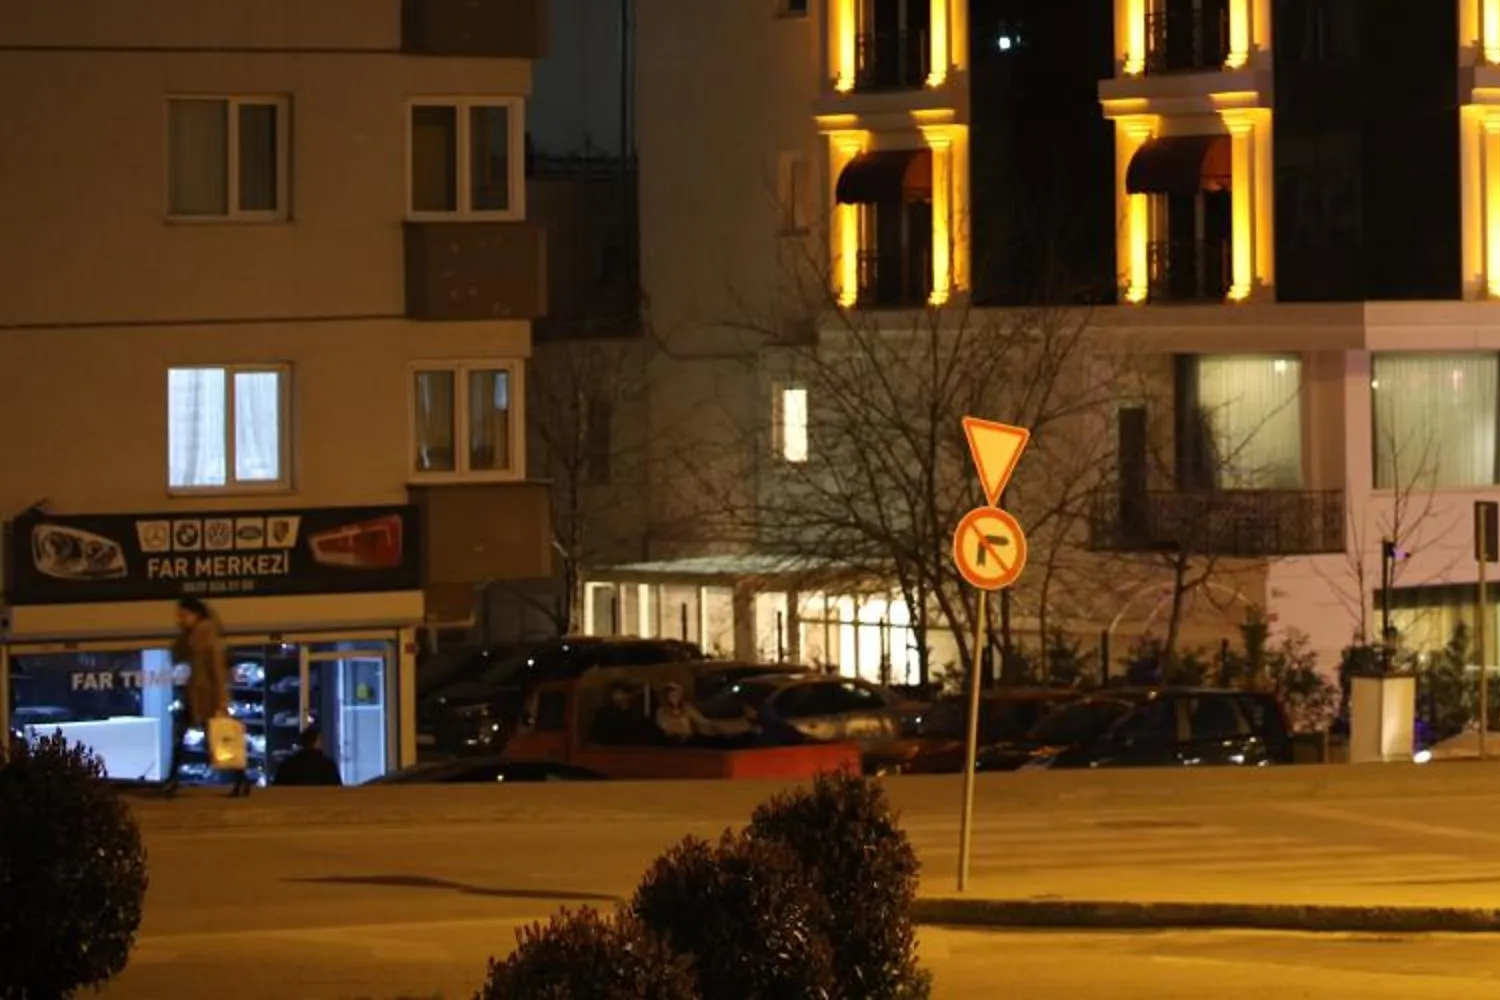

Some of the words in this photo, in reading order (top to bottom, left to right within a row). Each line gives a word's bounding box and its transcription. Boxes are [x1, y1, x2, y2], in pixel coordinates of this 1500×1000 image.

[147, 556, 189, 580] FAR
[194, 549, 290, 577] MERKEZİ
[71, 671, 114, 691] FAR
